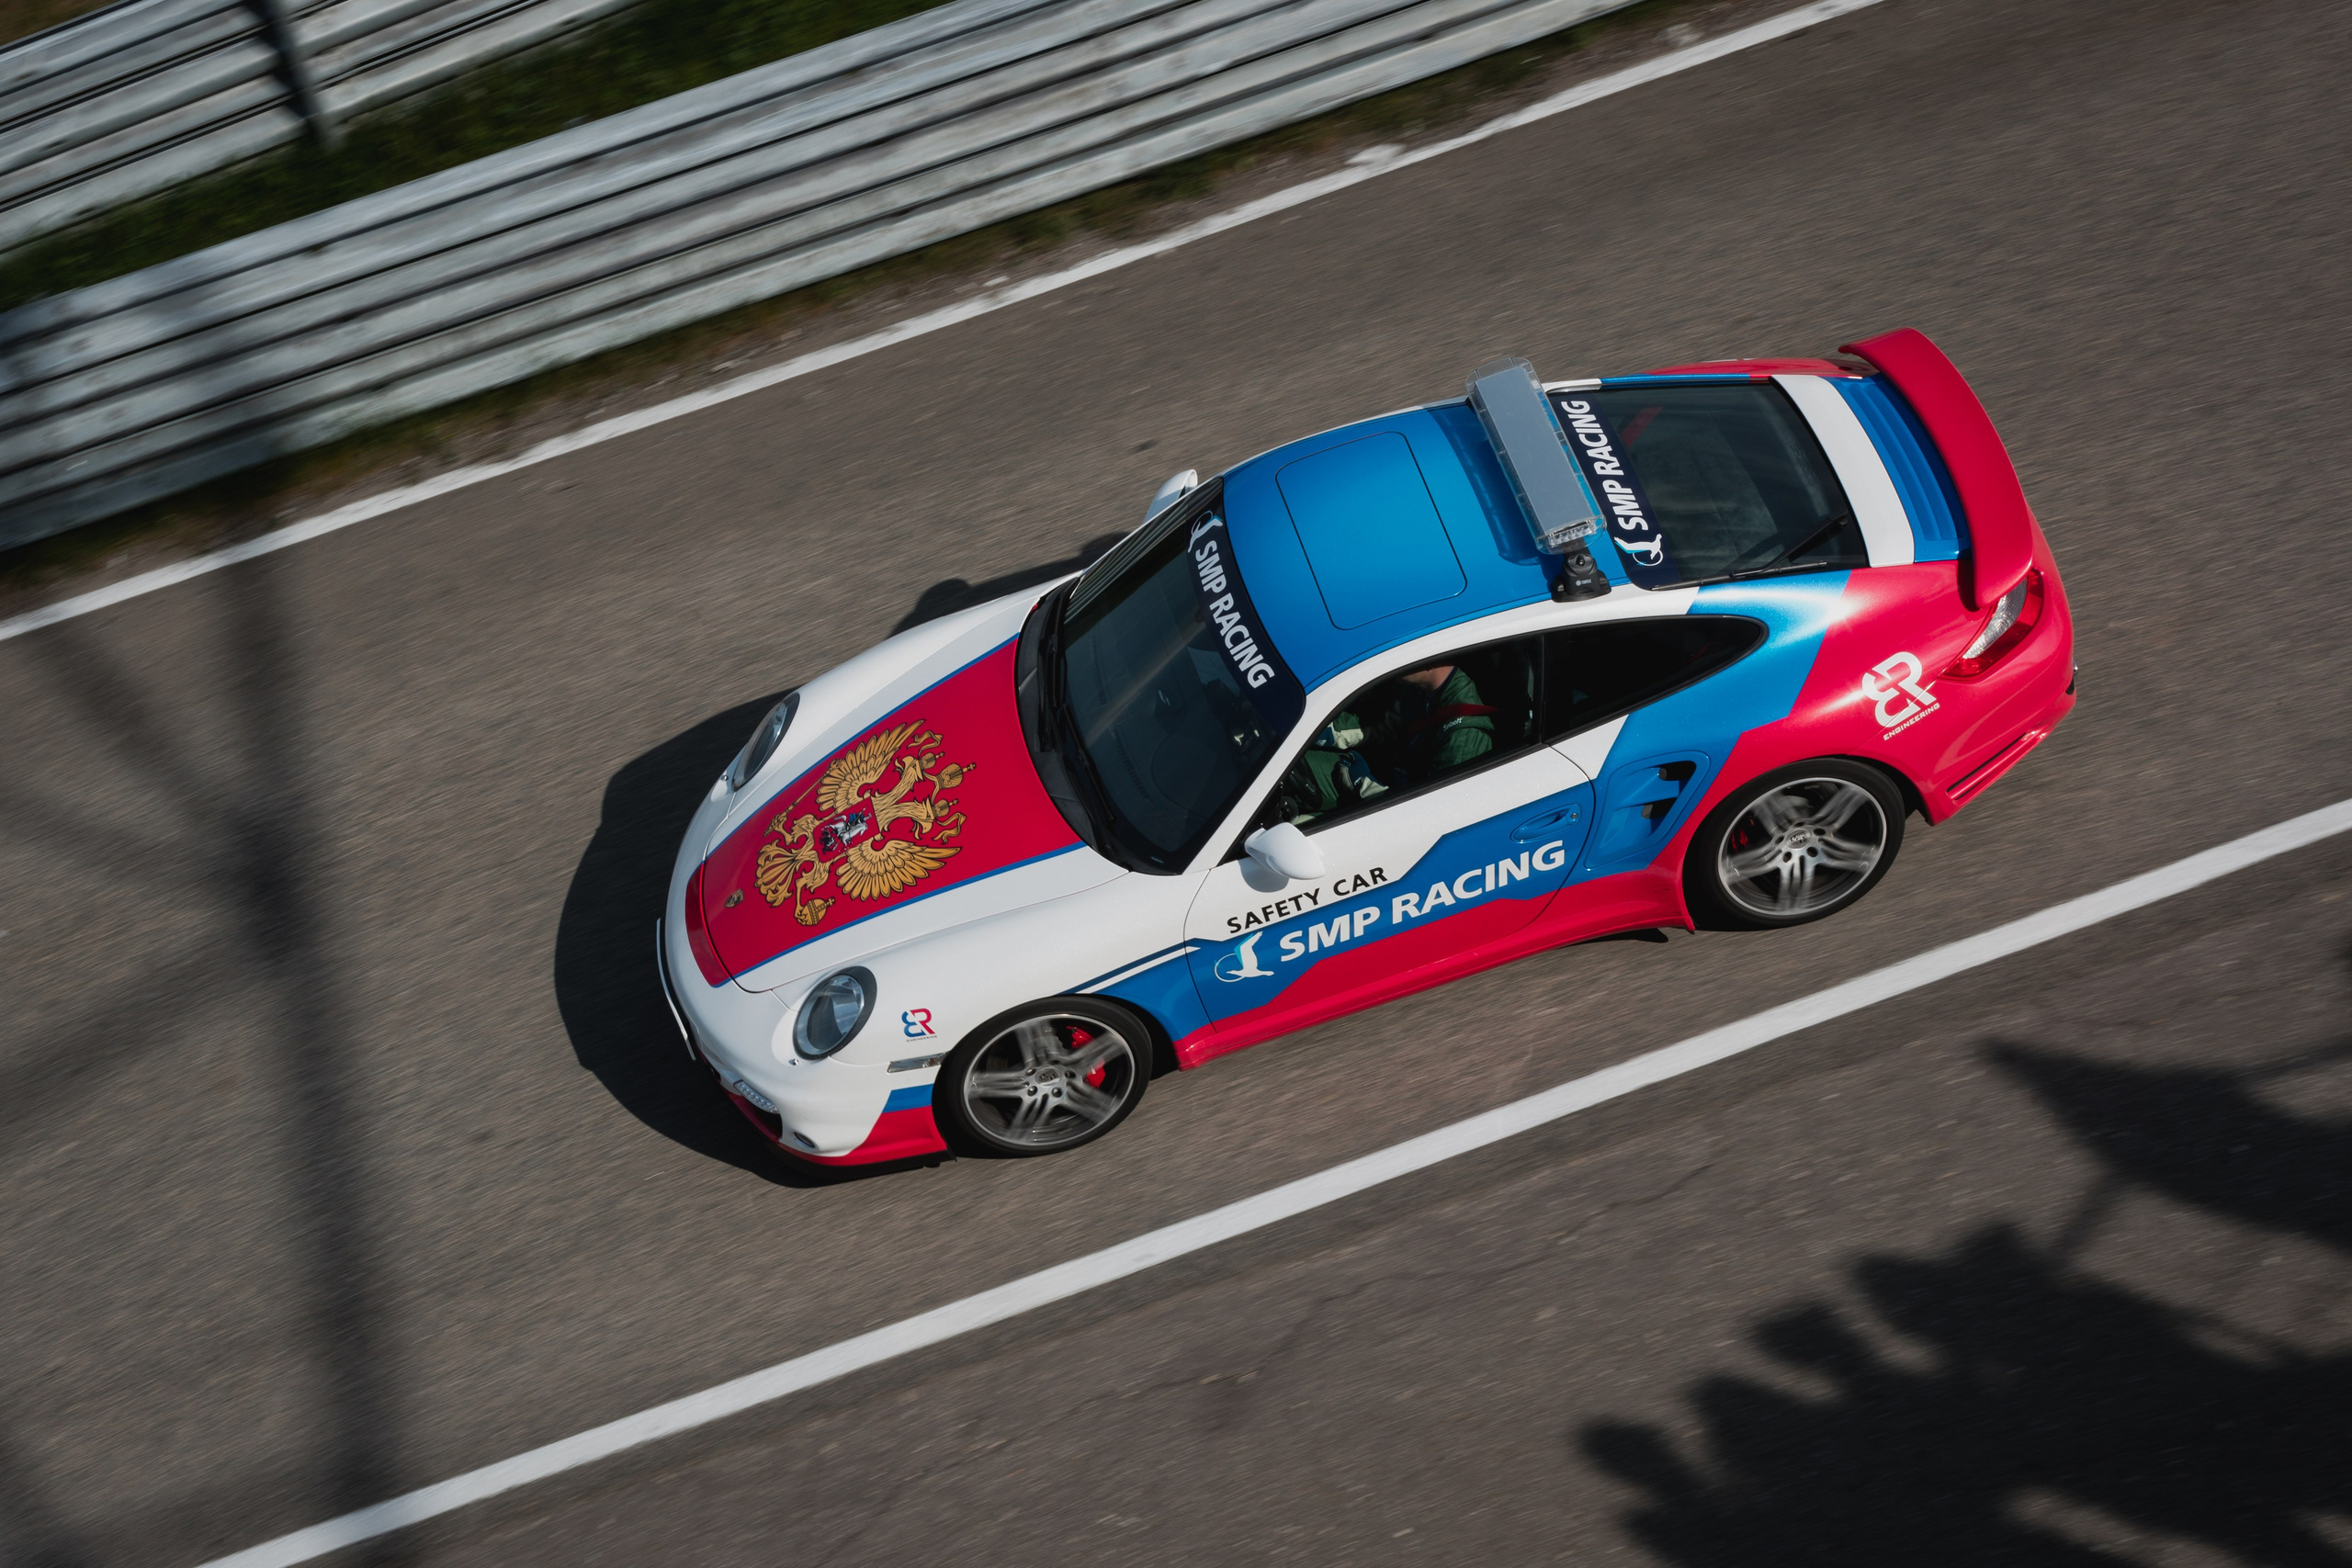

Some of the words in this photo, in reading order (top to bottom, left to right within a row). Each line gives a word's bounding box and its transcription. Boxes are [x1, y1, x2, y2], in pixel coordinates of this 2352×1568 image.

[1561, 400, 1624, 476] RACING
[1601, 479, 1649, 531] SMP
[1195, 540, 1227, 592] SMP
[1209, 592, 1275, 689] RACING
[1883, 702, 1940, 741] ENGINEERING
[1227, 888, 1320, 934] SAFETY
[1333, 867, 1388, 897] CAR
[1279, 907, 1381, 962] SMP
[1392, 840, 1565, 925] RACING
